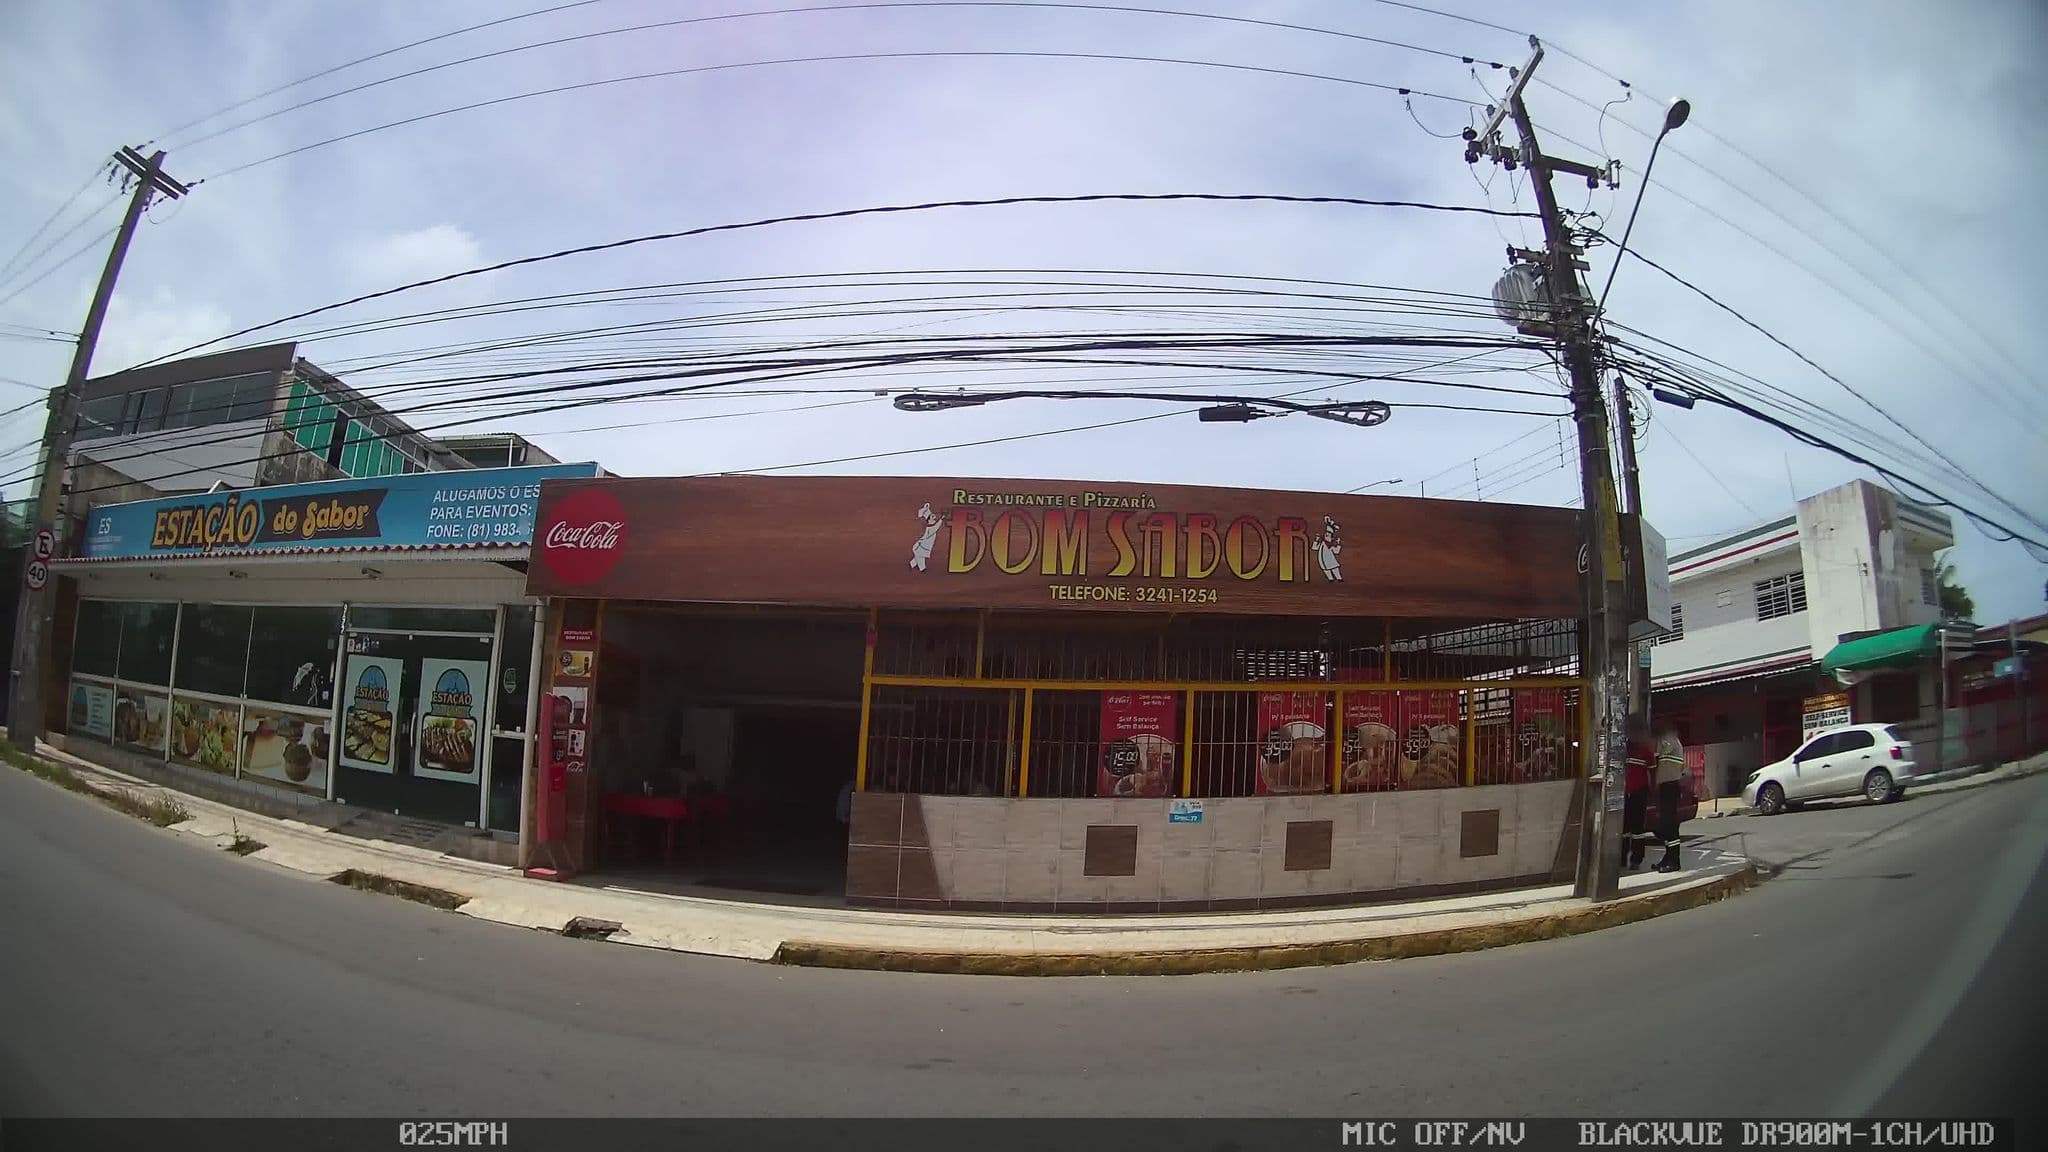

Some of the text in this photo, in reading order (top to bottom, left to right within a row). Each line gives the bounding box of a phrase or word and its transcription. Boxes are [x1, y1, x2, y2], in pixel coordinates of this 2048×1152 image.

[433, 486, 506, 503] ALUGAMOS
[509, 485, 521, 499] O
[430, 503, 532, 521] PARA EVENTOS:
[151, 495, 259, 551] ESTAÇÃO
[302, 499, 370, 539] Sabor
[427, 524, 464, 539] FONE:
[467, 523, 490, 540] (81)
[546, 520, 624, 550] Coca-Cola
[946, 507, 1310, 582] BOM SABOR
[29, 566, 45, 581] 40
[1050, 585, 1218, 603] TELEFONE: 3241-1254
[355, 686, 390, 701] ESTAÇÃO
[432, 691, 473, 706] ESTAÇÃO
